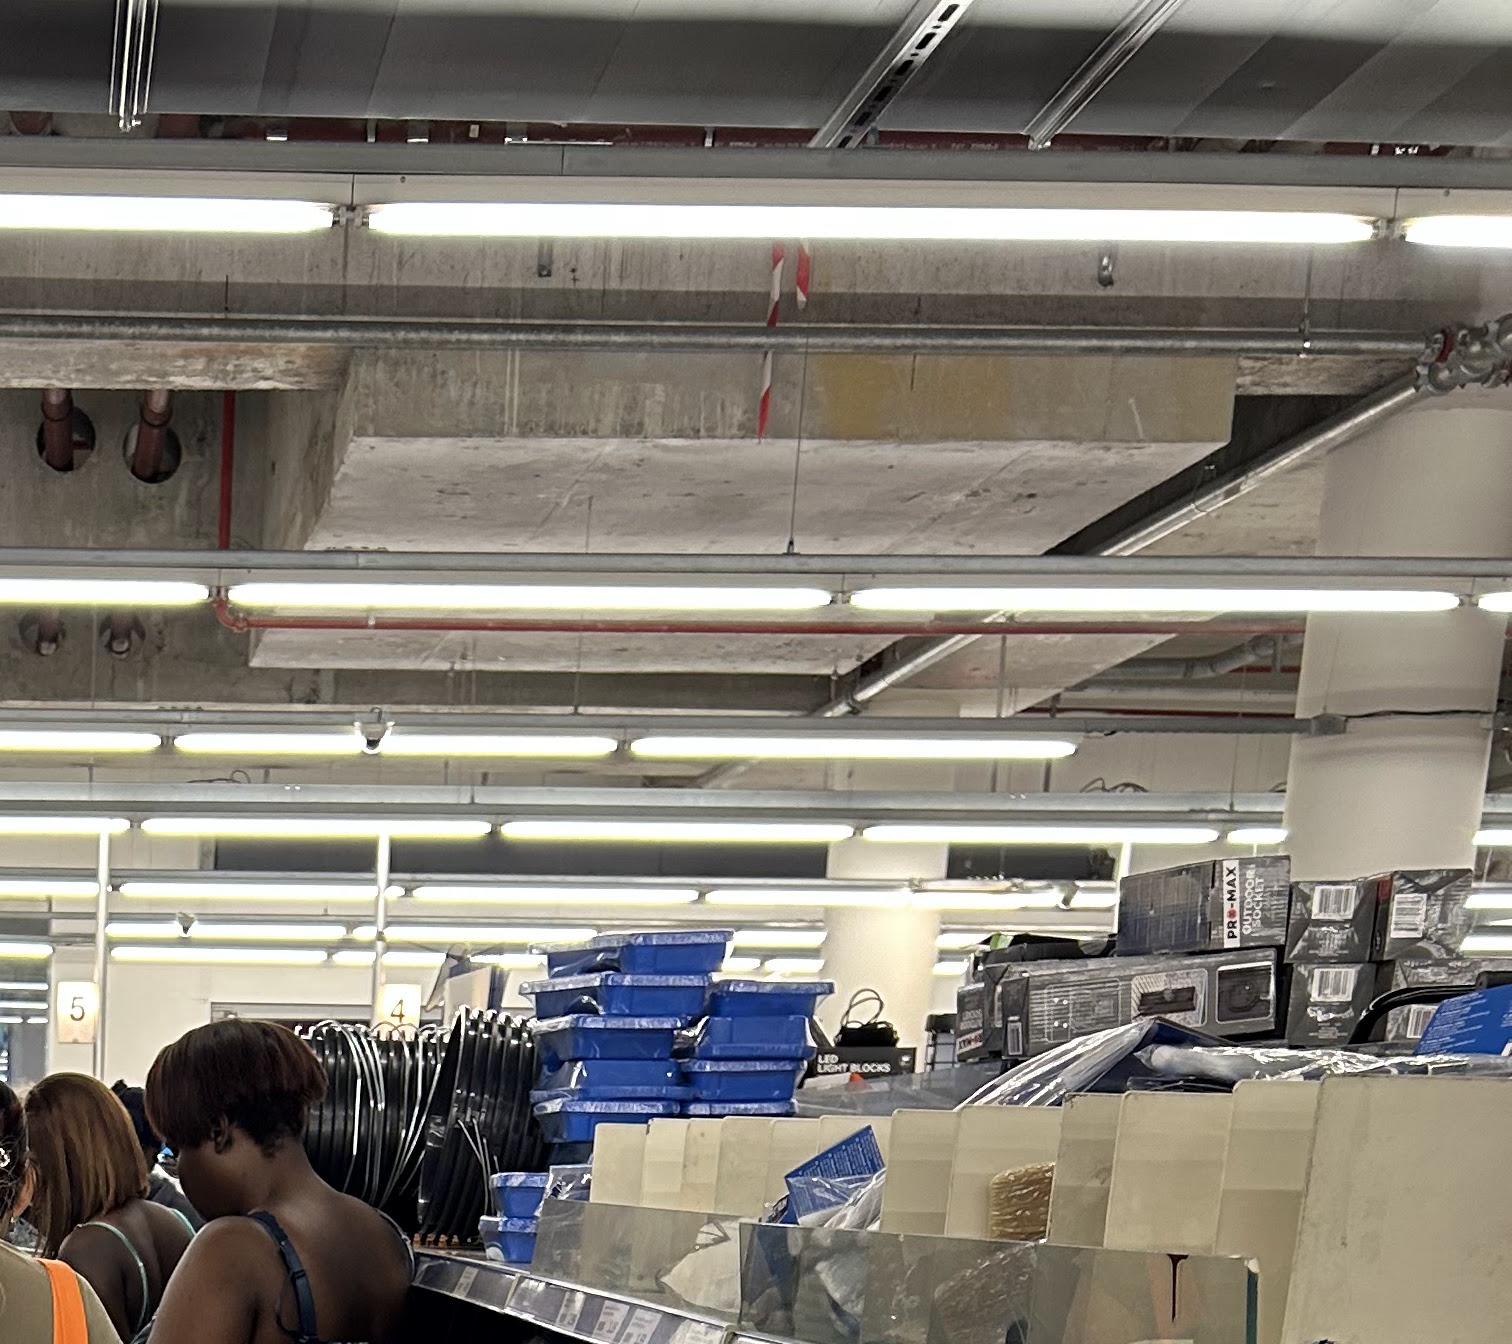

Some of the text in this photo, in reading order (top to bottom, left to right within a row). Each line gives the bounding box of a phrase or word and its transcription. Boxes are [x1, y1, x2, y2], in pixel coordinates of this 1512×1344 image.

[70, 996, 85, 1021] 5
[391, 999, 405, 1023] 4
[817, 1054, 838, 1064] LED
[817, 1063, 891, 1073] LIGHT BLOCKS
